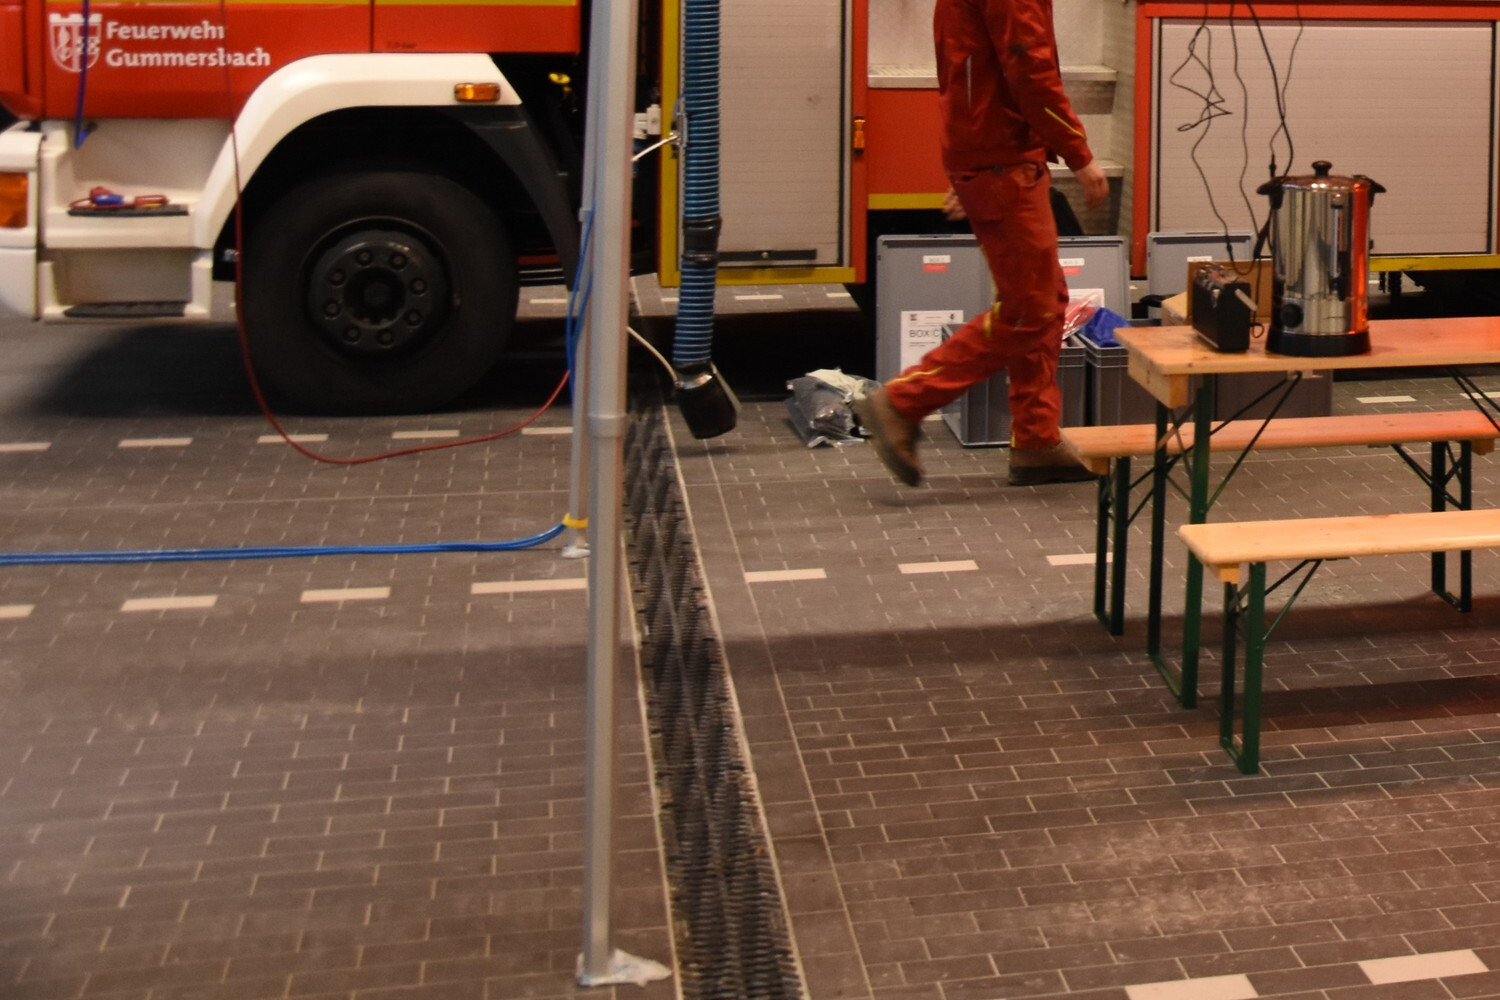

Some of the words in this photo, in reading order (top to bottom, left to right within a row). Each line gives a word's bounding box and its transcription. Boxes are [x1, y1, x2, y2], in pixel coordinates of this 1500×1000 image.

[106, 20, 225, 39] Feuerwehr
[106, 47, 270, 67] Gummersbach
[909, 329, 930, 338] BOX
